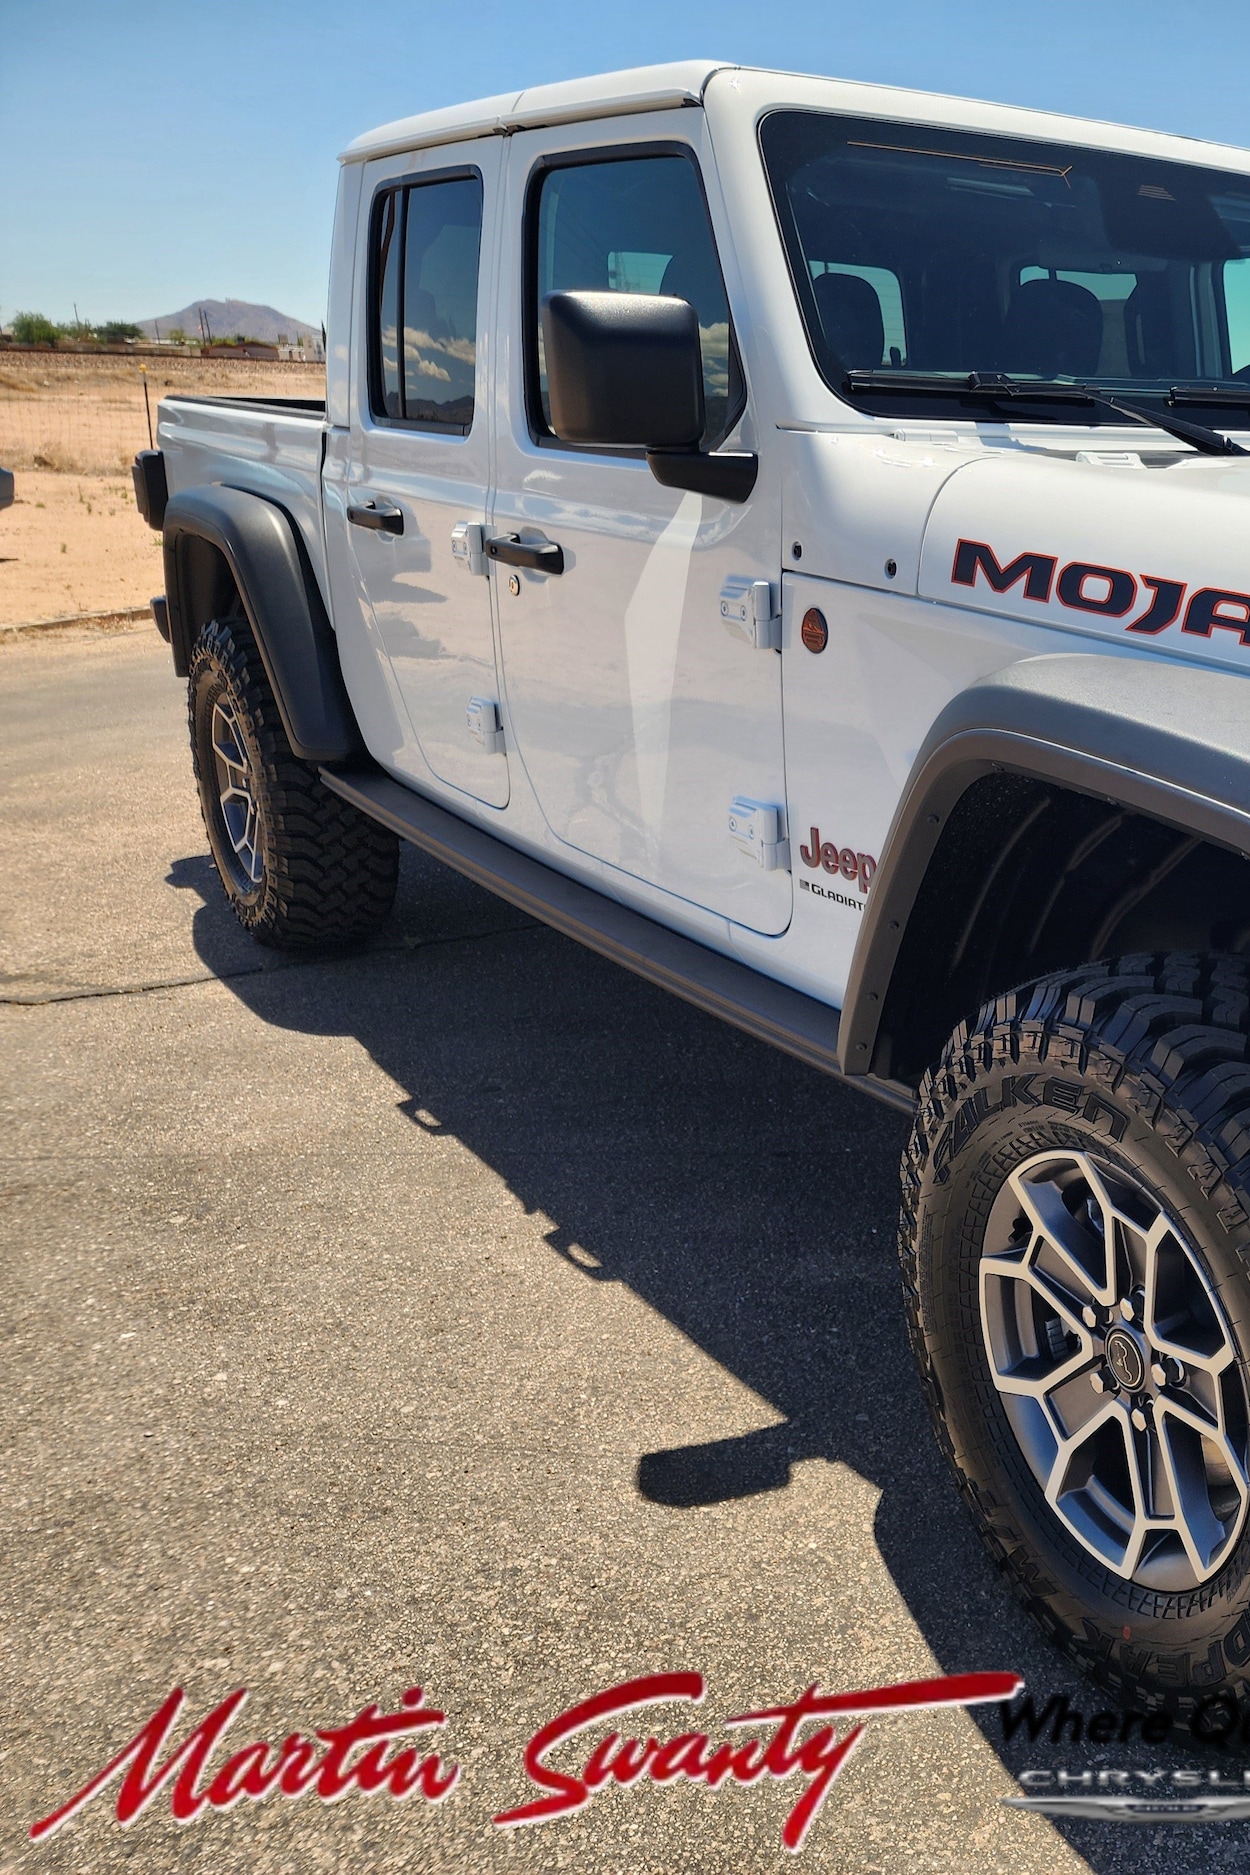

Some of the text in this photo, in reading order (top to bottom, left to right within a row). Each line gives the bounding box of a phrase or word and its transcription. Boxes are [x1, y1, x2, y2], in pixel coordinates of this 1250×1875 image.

[800, 826, 877, 894] Jeep
[811, 883, 867, 911] GLADIAT
[932, 1072, 1131, 1185] FALKEN
